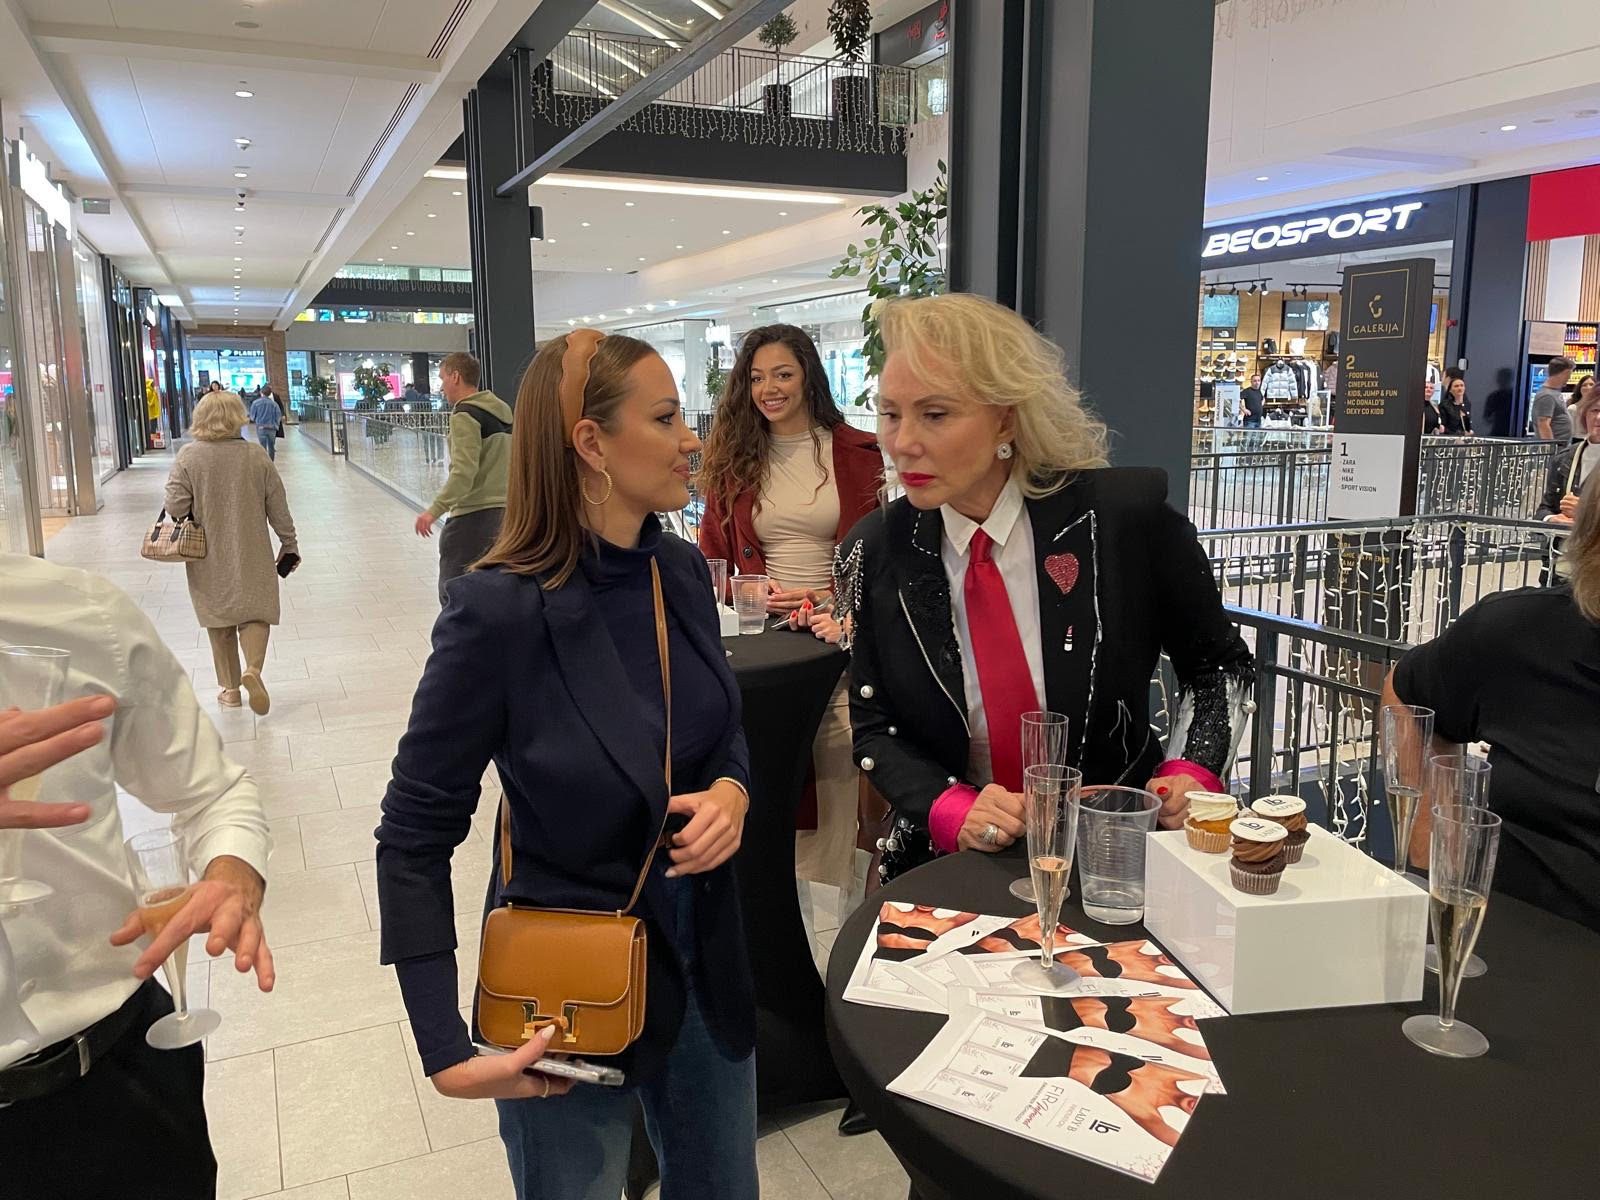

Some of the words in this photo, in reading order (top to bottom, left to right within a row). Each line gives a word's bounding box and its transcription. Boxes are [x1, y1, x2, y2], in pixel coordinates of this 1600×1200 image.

[1201, 202, 1422, 257] BEOSPORT
[1353, 323, 1399, 334] GALERIJA
[1346, 355, 1355, 370] 2
[1348, 371, 1364, 379] FOOD
[1385, 389, 1398, 397] FUN
[1340, 442, 1348, 457] 1
[1042, 1085, 1065, 1104] FIR
[1072, 1107, 1091, 1127] LADY
